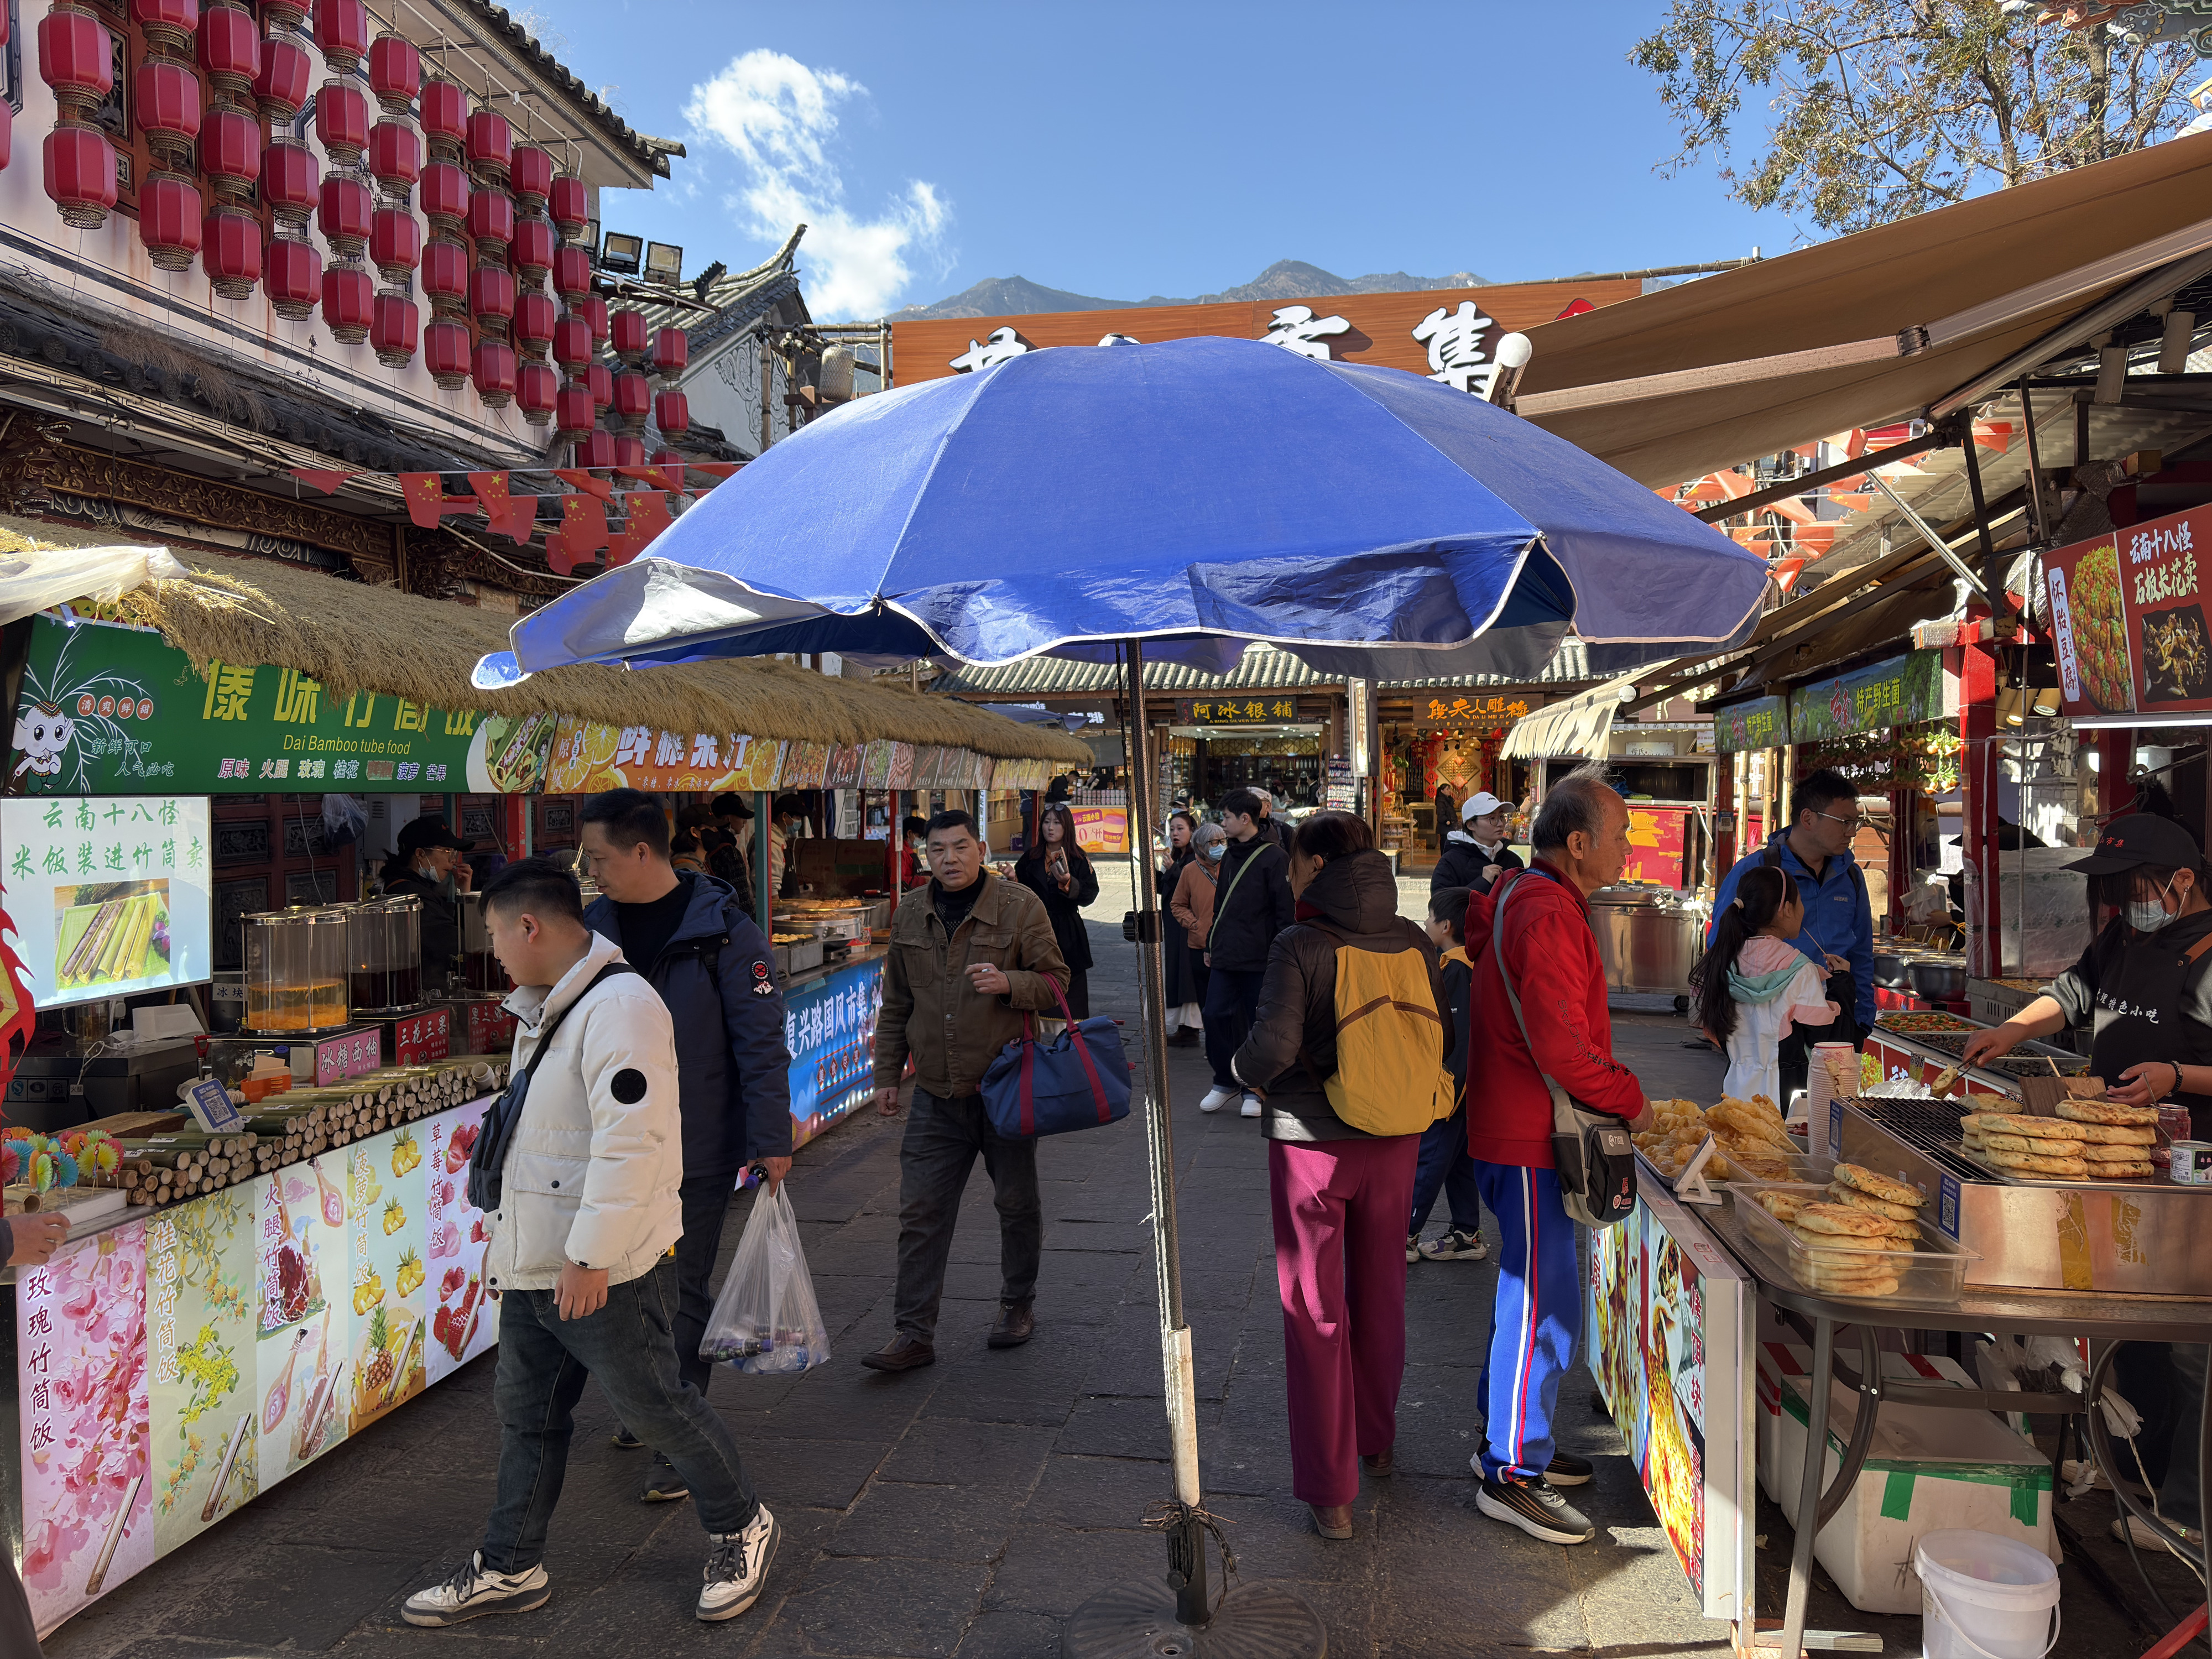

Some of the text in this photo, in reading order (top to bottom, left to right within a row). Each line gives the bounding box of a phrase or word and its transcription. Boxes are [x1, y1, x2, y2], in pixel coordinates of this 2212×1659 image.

[2130, 520, 2194, 565] 云南十八怪
[2051, 580, 2075, 691] 怀胎豆腐
[82, 699, 150, 714] 清爽鲜甜
[1193, 701, 1292, 719] 阿冰银铺
[1427, 696, 1530, 720] 段夫人雕梅
[1856, 676, 1901, 714] 特产野生菌
[1747, 709, 1772, 735] 特产野生菌
[91, 738, 153, 754] 新鲜可口
[283, 734, 411, 755] Dai Bamboo tube food
[114, 761, 175, 777] 人气必吃
[218, 758, 249, 779] 原味
[259, 759, 290, 779] 火腿
[298, 759, 326, 779] 玫瑰
[333, 760, 359, 780] 桂花
[397, 762, 420, 781] 菠萝
[426, 764, 447, 782] 芒果
[43, 798, 180, 832] 云南十八怪
[11, 836, 204, 881] 米饭装进竹筒卖
[217, 987, 243, 998] 冰块
[399, 1014, 447, 1048] 三花三果
[785, 981, 869, 1061] 复兴路国风市集
[321, 1035, 377, 1075] 冰糖西柚
[430, 1122, 445, 1248] 草莓竹筒饭
[353, 1151, 372, 1287] 菠萝竹筒饭
[262, 1182, 282, 1329] 火腿竹筒饭
[154, 1220, 180, 1385] 桂花竹筒饭
[26, 1266, 56, 1454] 玫瑰竹筒饭
[1691, 1283, 1702, 1417] 烤饵块
